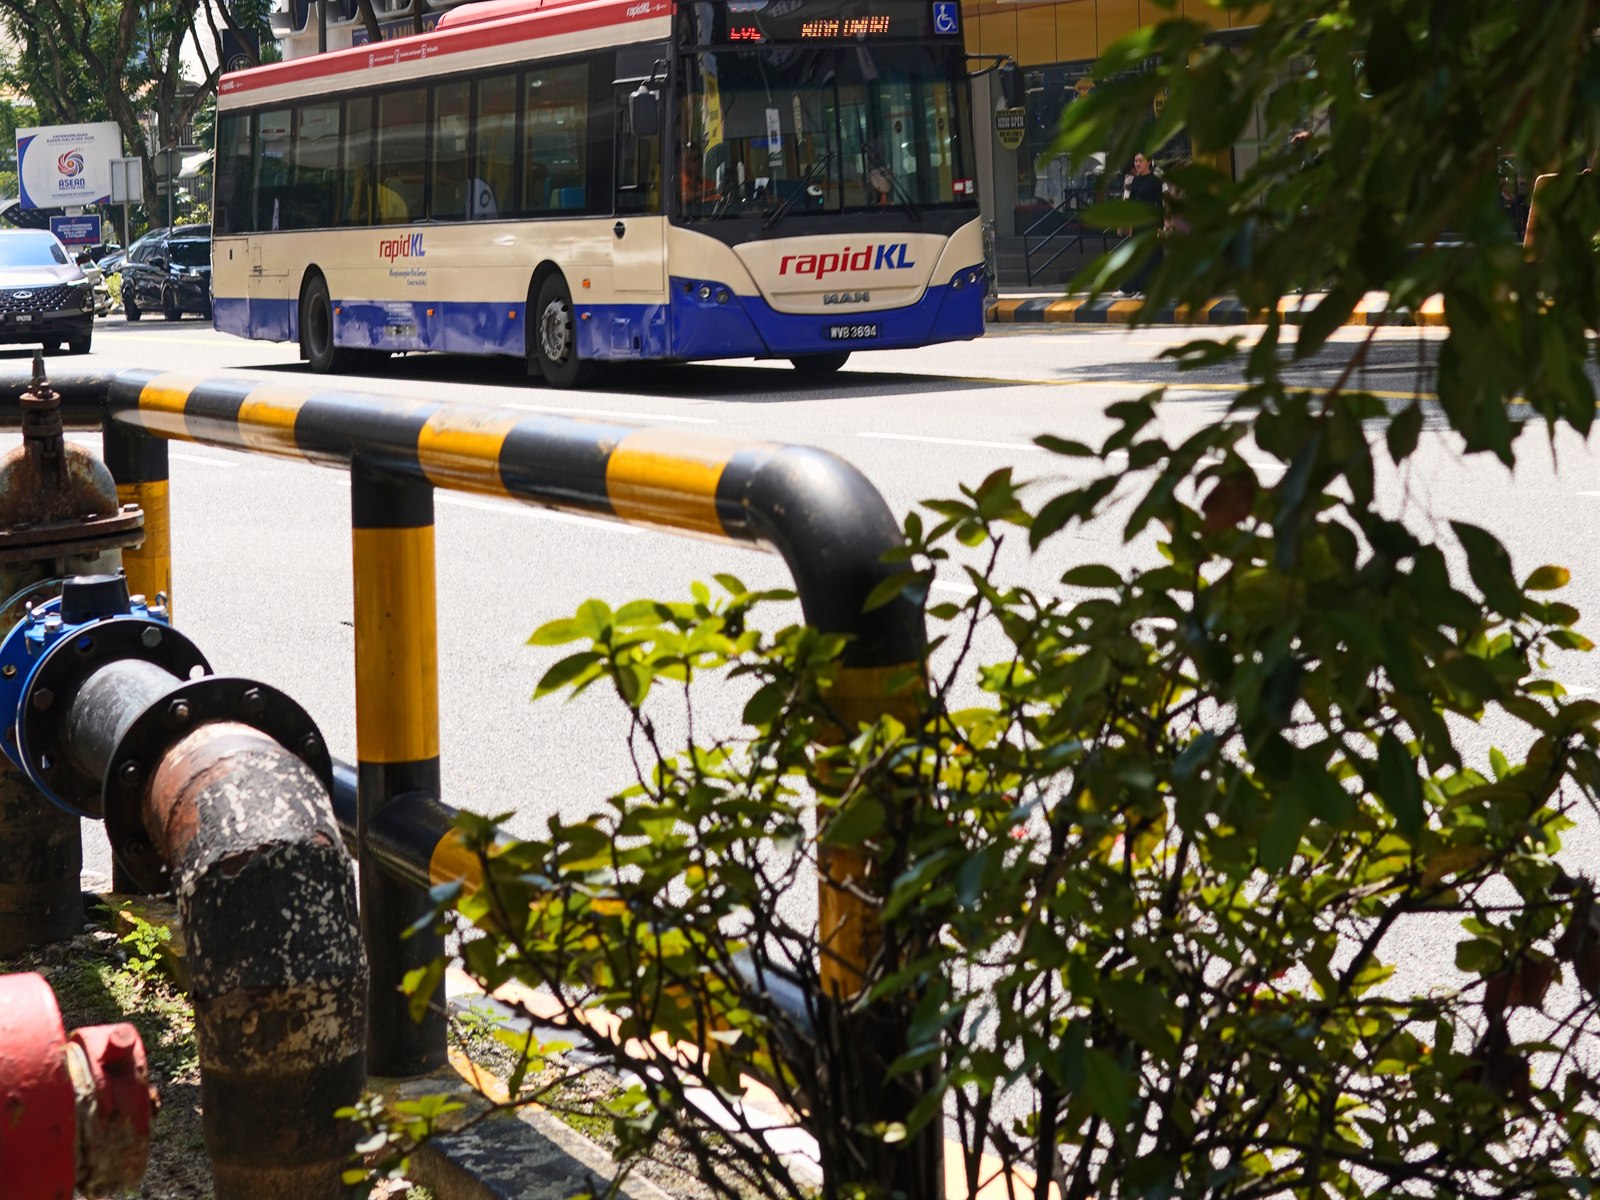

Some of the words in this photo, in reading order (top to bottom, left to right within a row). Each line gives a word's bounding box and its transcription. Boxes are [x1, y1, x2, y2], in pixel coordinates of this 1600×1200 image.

[626, 1, 651, 19] rapidKL
[997, 116, 1010, 129] NOW
[1010, 115, 1024, 128] OPEN
[59, 178, 85, 187] ASEAN
[379, 233, 426, 264] rapidKL
[779, 243, 916, 280] rapidKL
[823, 291, 870, 305] MAN
